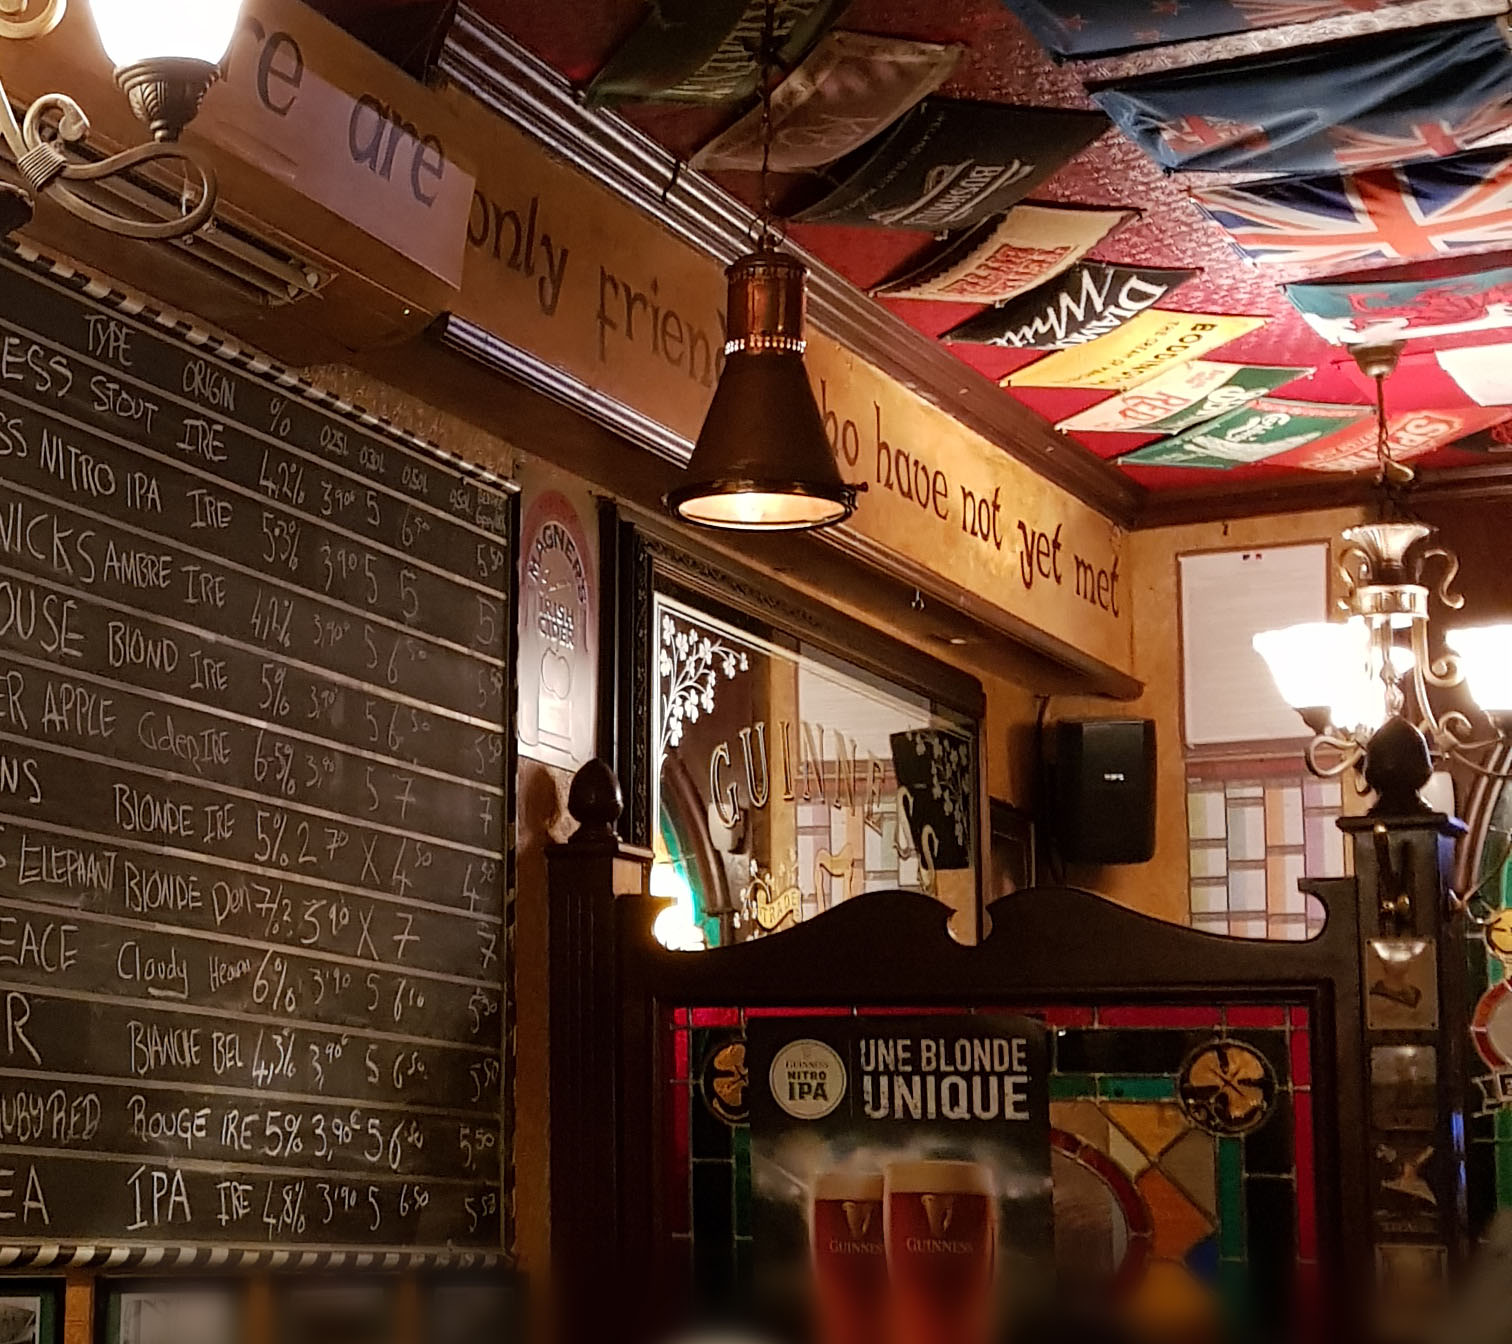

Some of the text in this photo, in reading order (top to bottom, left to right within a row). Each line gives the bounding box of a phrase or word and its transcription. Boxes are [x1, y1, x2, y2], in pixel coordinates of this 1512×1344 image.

[84, 313, 237, 413] TYPE ORIGIN
[348, 92, 445, 208] are
[467, 186, 569, 316] only
[819, 378, 861, 468] ho
[874, 400, 950, 522] have
[959, 484, 1003, 552] not
[1016, 519, 1063, 589] yet
[1073, 549, 1121, 619] met
[90, 375, 160, 434] STOUT
[176, 418, 229, 462] IRE
[40, 428, 117, 497] NITRO
[126, 471, 162, 514] IPA
[103, 540, 173, 589] AMBRE
[182, 565, 227, 609] IRE
[41, 681, 117, 738] APPLE
[18, 834, 119, 891] ELEPHANT
[211, 1031, 244, 1075] BEL
[787, 1070, 828, 1082] NITRO
[859, 1038, 1029, 1073] UNE BLONDE
[787, 1082, 829, 1102] IPA
[862, 1074, 1031, 1121] UNIQUE
[220, 1108, 262, 1153] IRE
[125, 1164, 192, 1231] IPA
[215, 1180, 254, 1226] IRE
